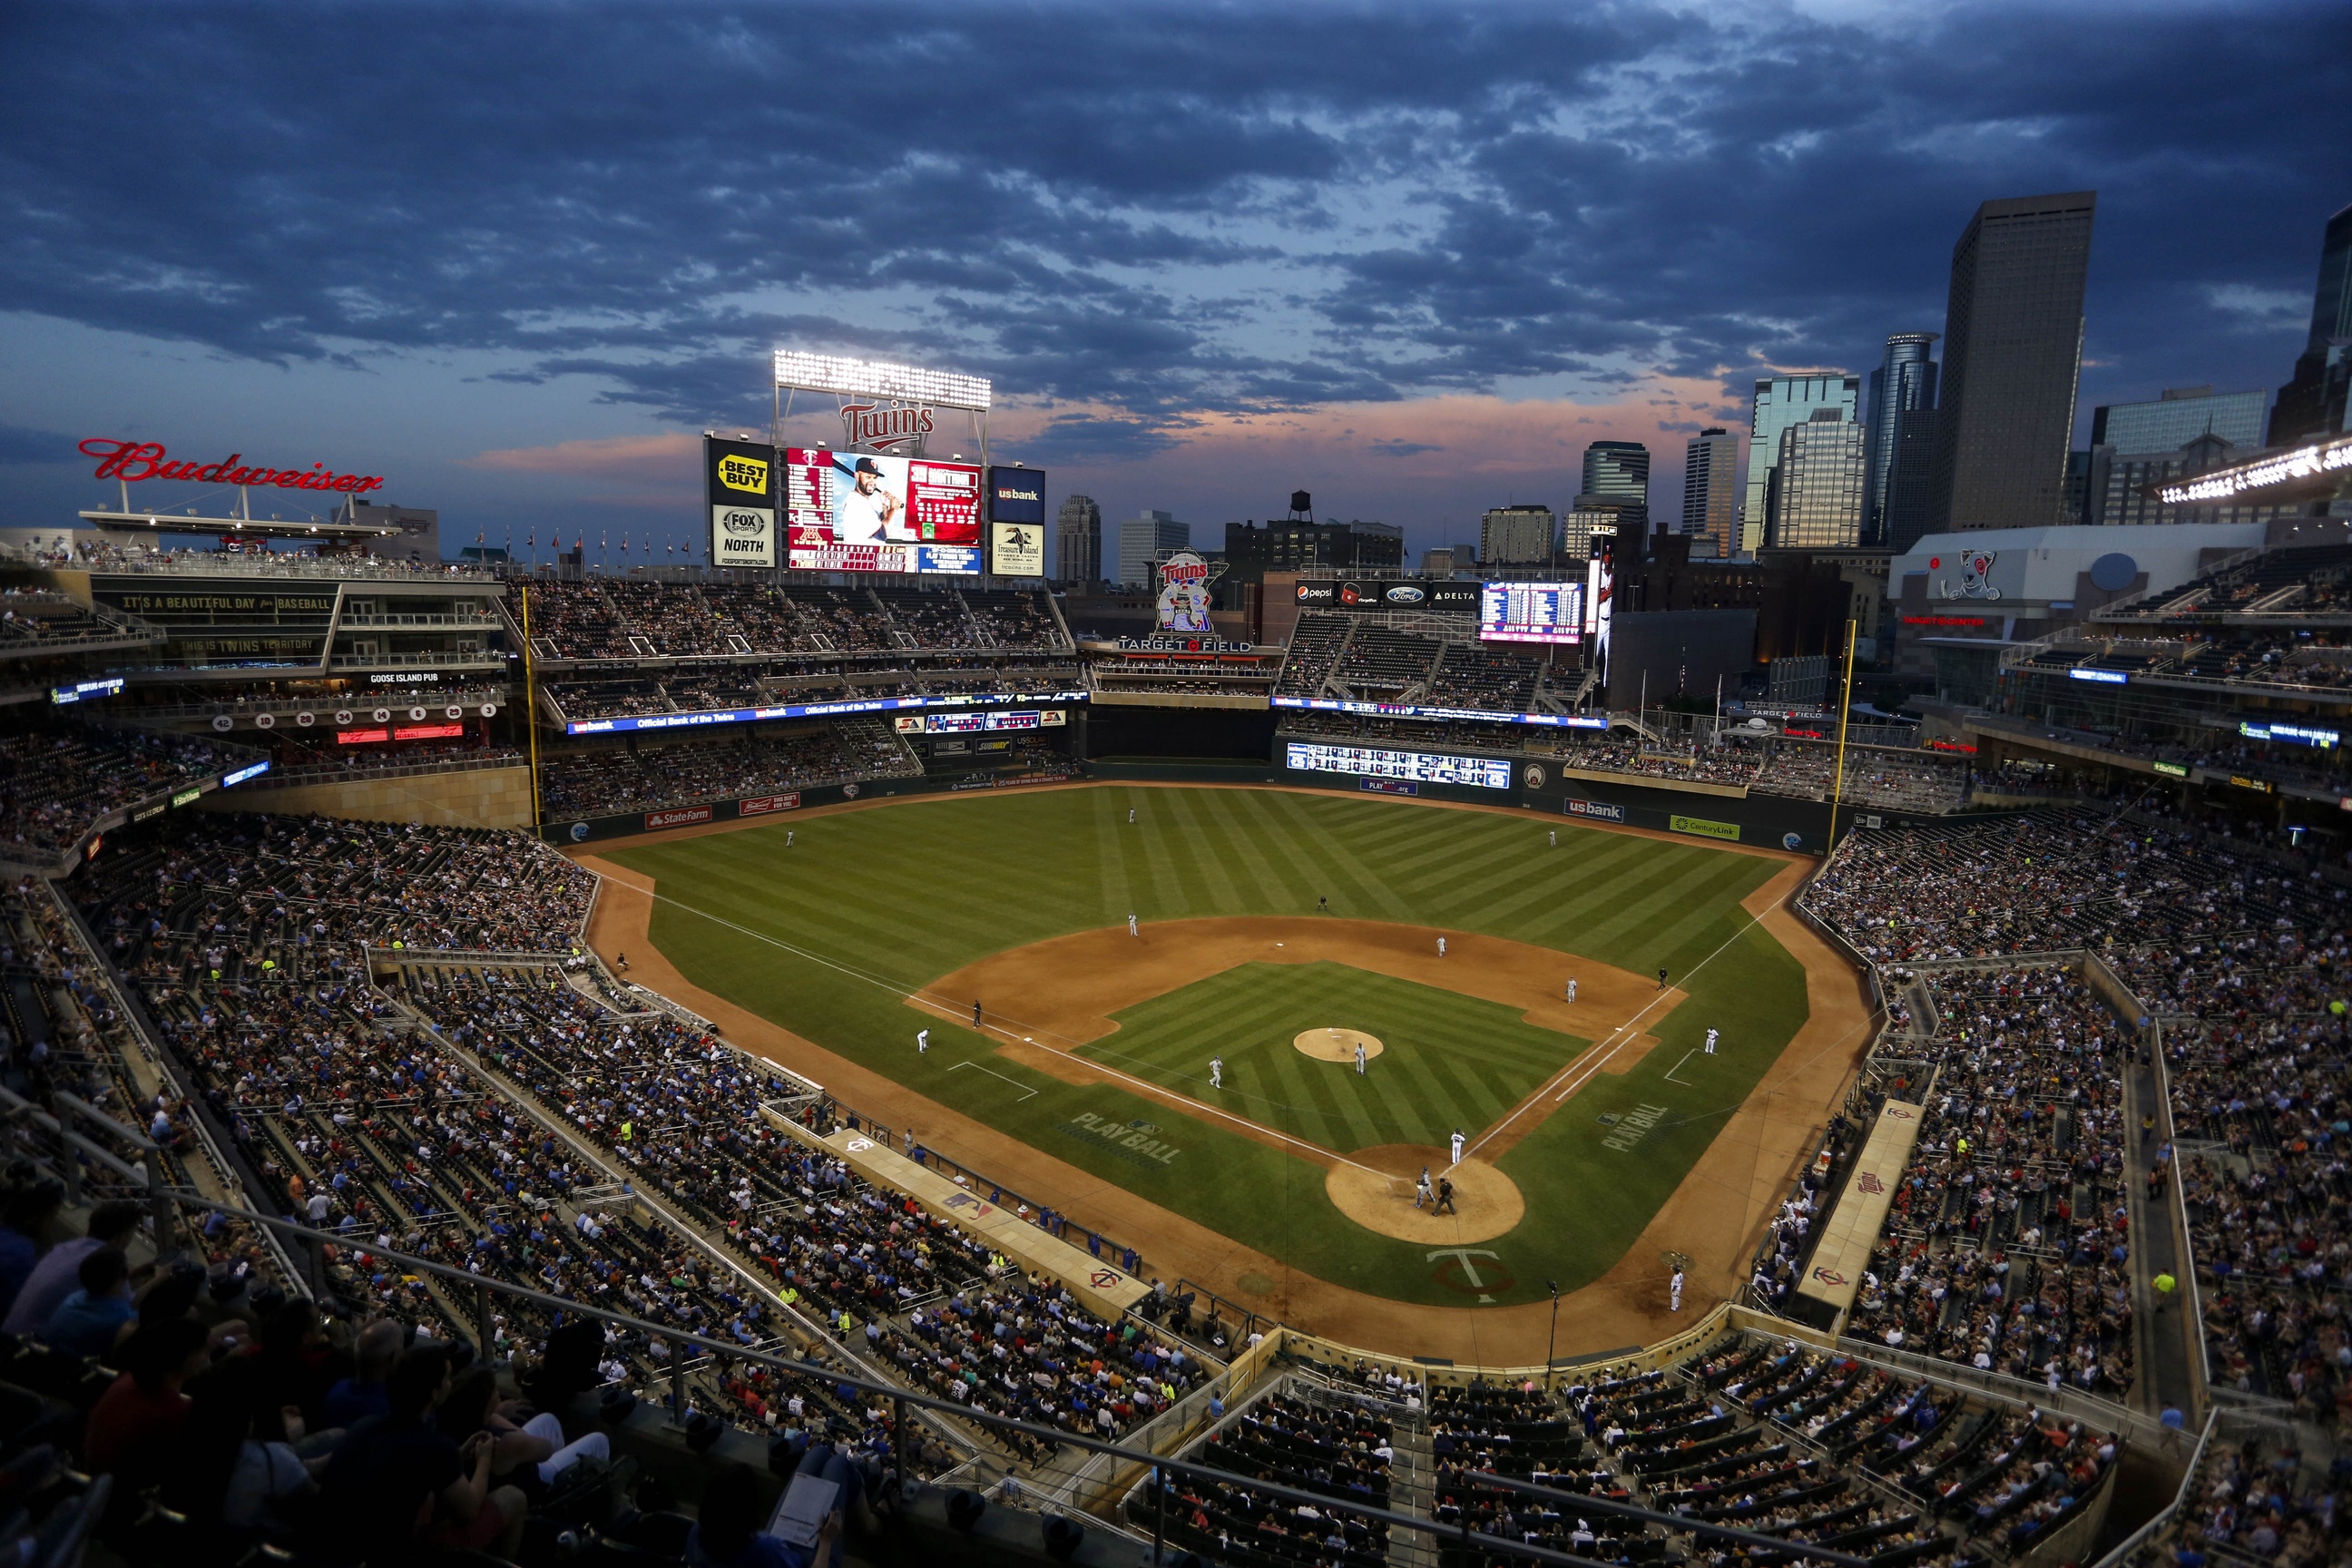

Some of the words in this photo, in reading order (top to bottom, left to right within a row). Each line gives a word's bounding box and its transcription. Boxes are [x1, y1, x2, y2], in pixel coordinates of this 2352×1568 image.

[840, 399, 934, 446] Twins
[78, 438, 385, 493] Budweiser
[725, 460, 766, 477] BEST
[726, 473, 761, 488] BUY
[732, 514, 755, 527] FOX
[724, 539, 764, 553] NORTH
[997, 544, 1018, 554] Treasure
[1024, 545, 1038, 554] Island
[1161, 563, 1208, 585] Twins
[1309, 588, 1332, 598] pepsi
[1394, 590, 1416, 601] Ford
[122, 597, 150, 608] IT'S
[155, 598, 162, 608] A
[167, 598, 233, 609] BEAUTIFUL
[235, 598, 255, 609] DAY
[260, 599, 273, 608] for
[278, 598, 329, 609] BASEBALL
[1193, 595, 1200, 605] S
[1903, 616, 1937, 625] TARGET
[1947, 618, 1984, 626] CENTER
[182, 641, 202, 651] THIS
[206, 641, 215, 650] IS
[219, 640, 260, 652] TWINS
[262, 639, 312, 650] TERRITORY
[1119, 640, 1185, 650] TARGET
[1203, 642, 1251, 652] FIELD
[371, 674, 394, 683] GOOSE
[396, 674, 422, 682] ISLAND
[424, 673, 438, 681] PUB
[377, 711, 387, 720] 14
[486, 706, 491, 714] 3
[805, 706, 828, 715] Official
[829, 705, 845, 713] Bank
[260, 717, 270, 725] 10
[338, 713, 349, 721] 34
[637, 719, 667, 728] Official
[668, 717, 688, 726] Bank
[690, 716, 699, 724] of
[713, 713, 735, 721] Twins
[217, 719, 230, 728] 42
[1784, 728, 1802, 736] Great
[1805, 730, 1821, 738] Clips
[978, 740, 1010, 750] SUBWAY
[1934, 740, 1955, 751] Great
[1958, 742, 1978, 753] Clips
[1690, 822, 1734, 836] CenturyLink
[1601, 1122, 1645, 1152] PLAY
[1623, 1103, 1668, 1129] BALL
[1071, 1112, 1133, 1139] PLAY
[1120, 1132, 1181, 1164] BALL
[952, 1387, 960, 1397] 25
